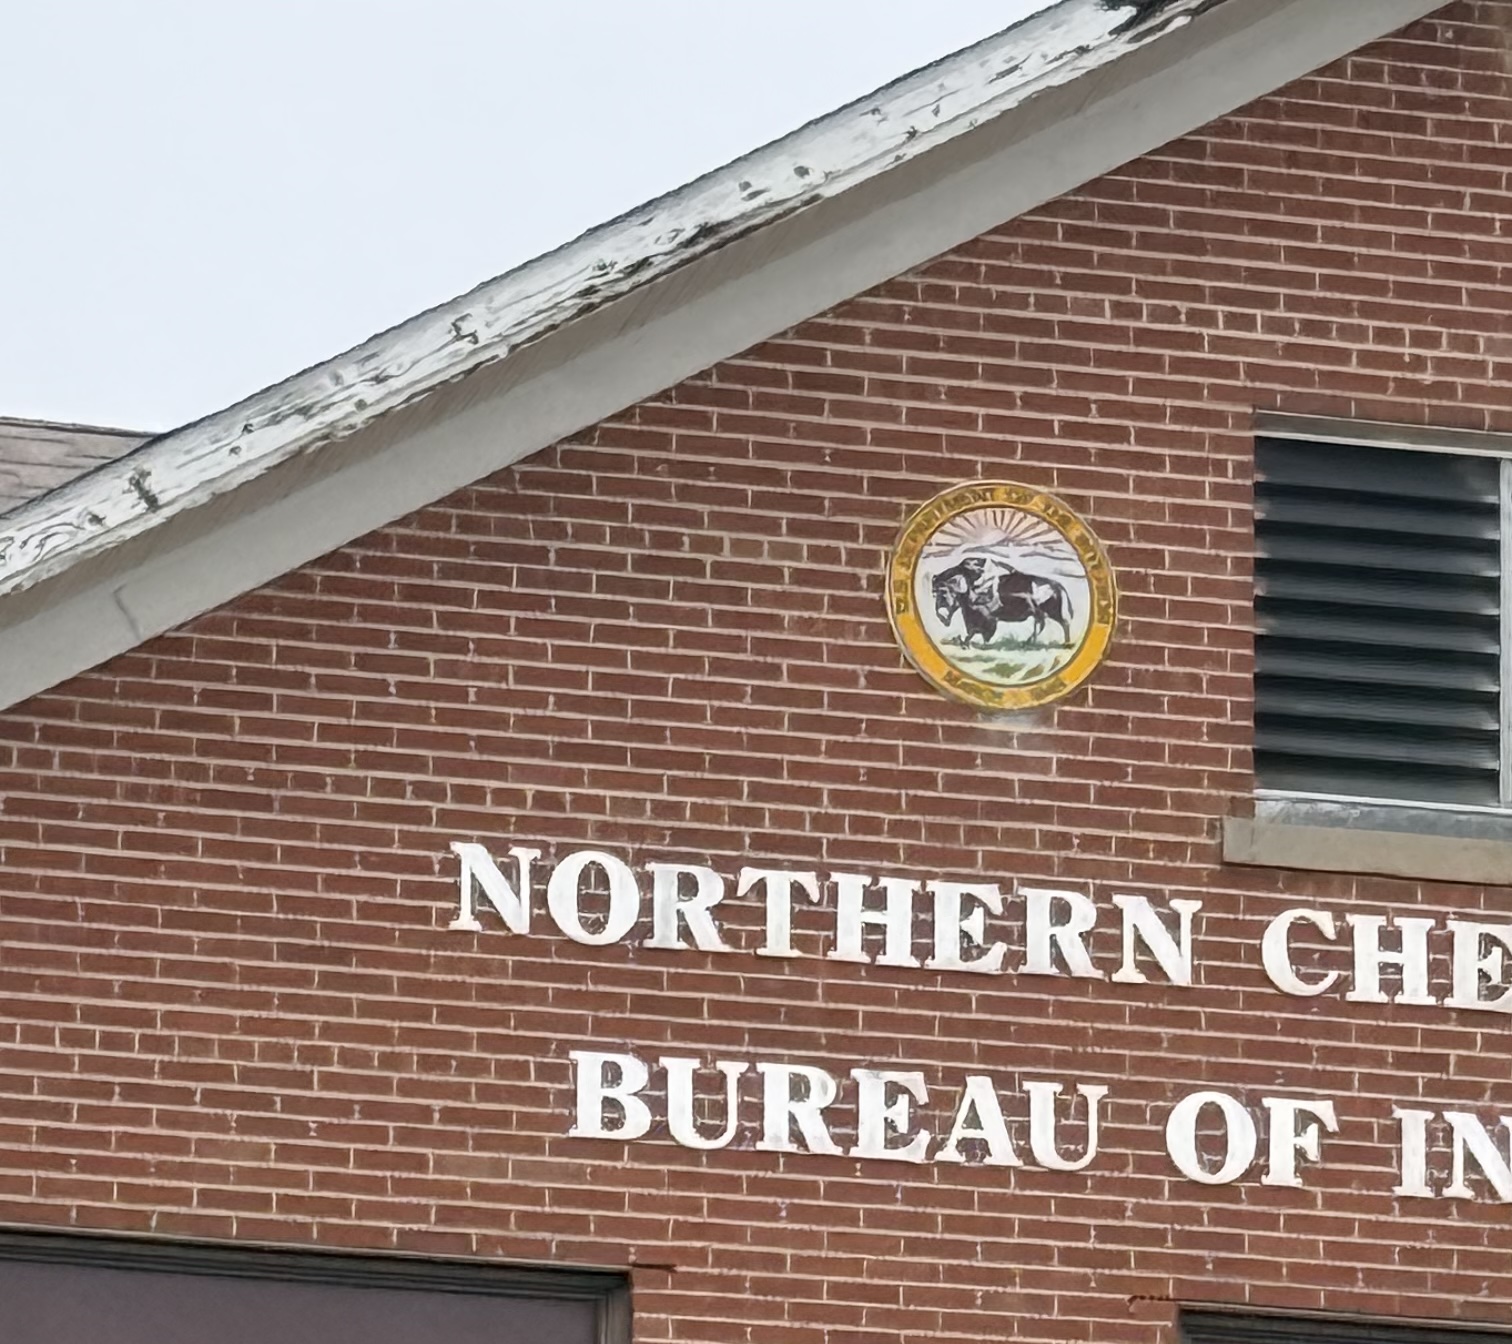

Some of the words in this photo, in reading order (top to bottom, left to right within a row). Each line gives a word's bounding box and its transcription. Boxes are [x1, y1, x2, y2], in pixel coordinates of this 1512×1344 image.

[449, 841, 1203, 986] NORTHERN
[567, 1049, 1110, 1172] BUREAU
[1164, 1090, 1338, 1188] OF
